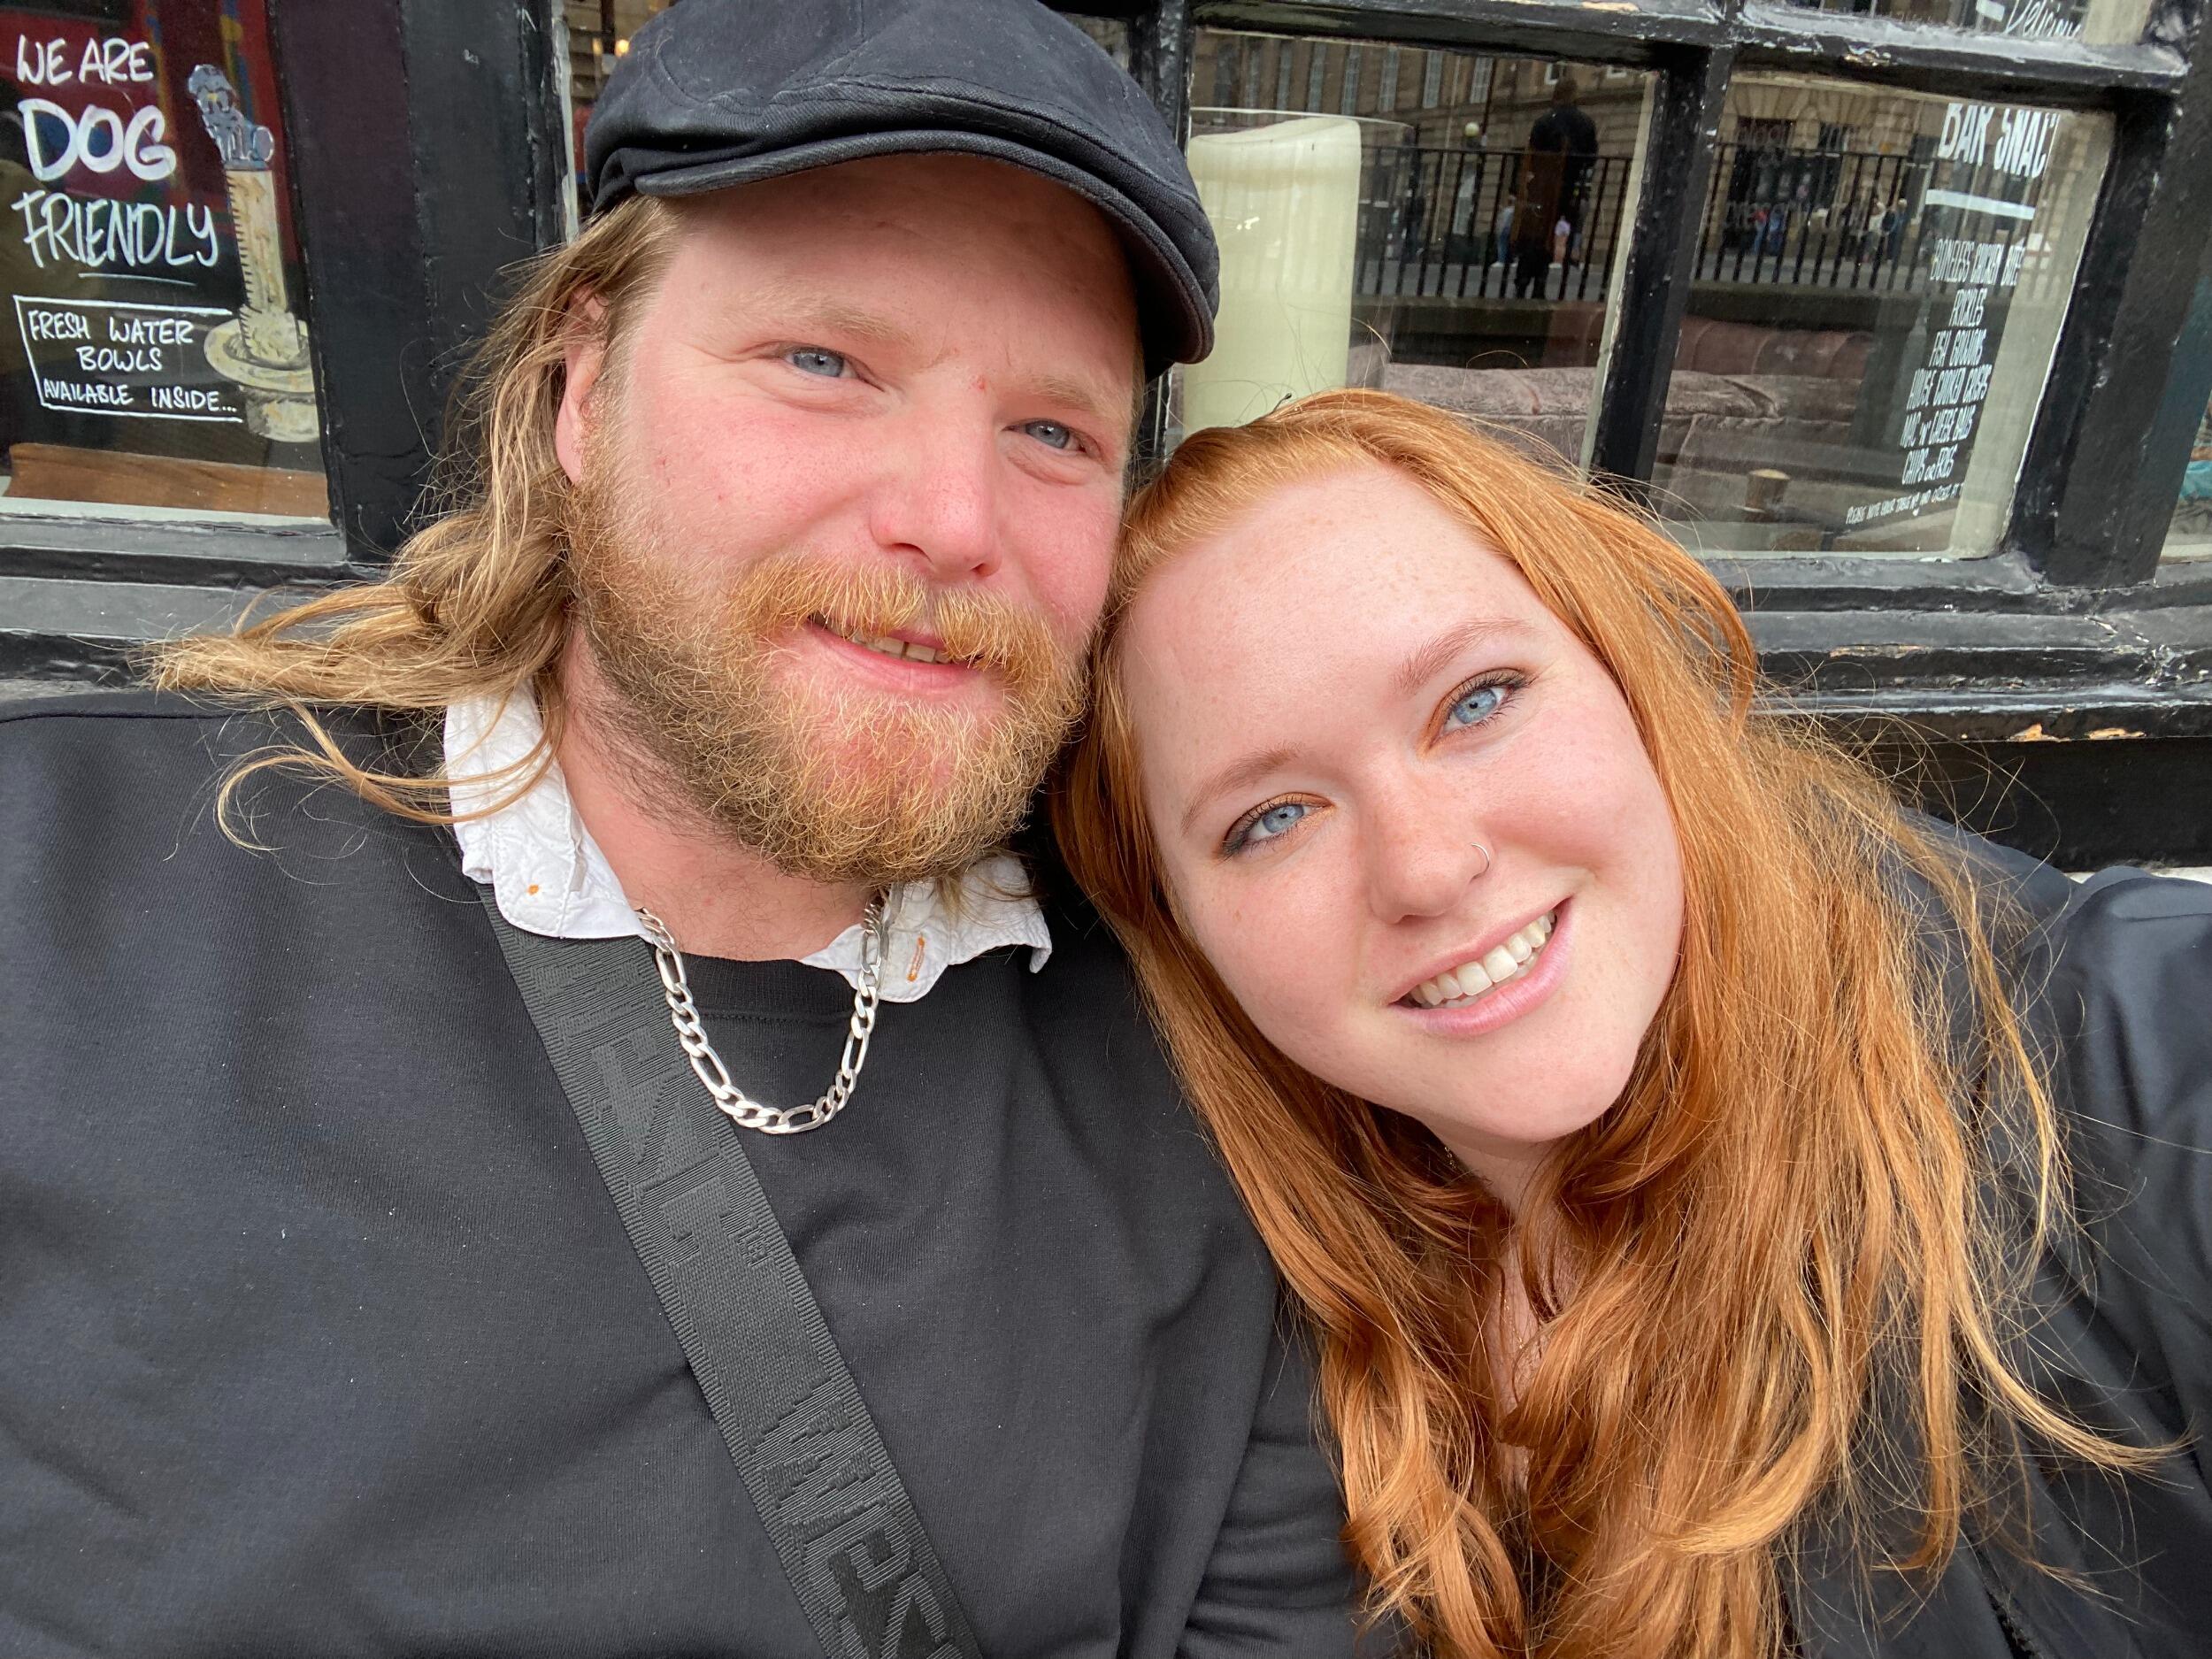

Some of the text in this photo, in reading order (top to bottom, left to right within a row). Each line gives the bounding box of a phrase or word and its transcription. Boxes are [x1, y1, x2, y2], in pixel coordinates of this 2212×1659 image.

[17, 34, 154, 86] WE ARE
[18, 98, 177, 181] DOG
[1938, 103, 1994, 167] BAR
[1993, 108, 2057, 179] SNAC
[11, 190, 219, 268] FRIENDLY
[1930, 238, 2026, 286] BONELESS CHICKEN BITE
[29, 310, 194, 346] FRESH WATER
[1929, 329, 1952, 367] FISH
[76, 346, 162, 373] BOWLS
[43, 377, 134, 406] AVAILABLE
[1907, 364, 1993, 411] HOUSE COOKED CRISPS
[1900, 411, 1922, 449] MAC
[1928, 409, 1958, 445] CHEESE
[1952, 404, 1977, 442] BALLS
[1901, 447, 1930, 485] CHIPS
[1933, 443, 1958, 479] FRIES
